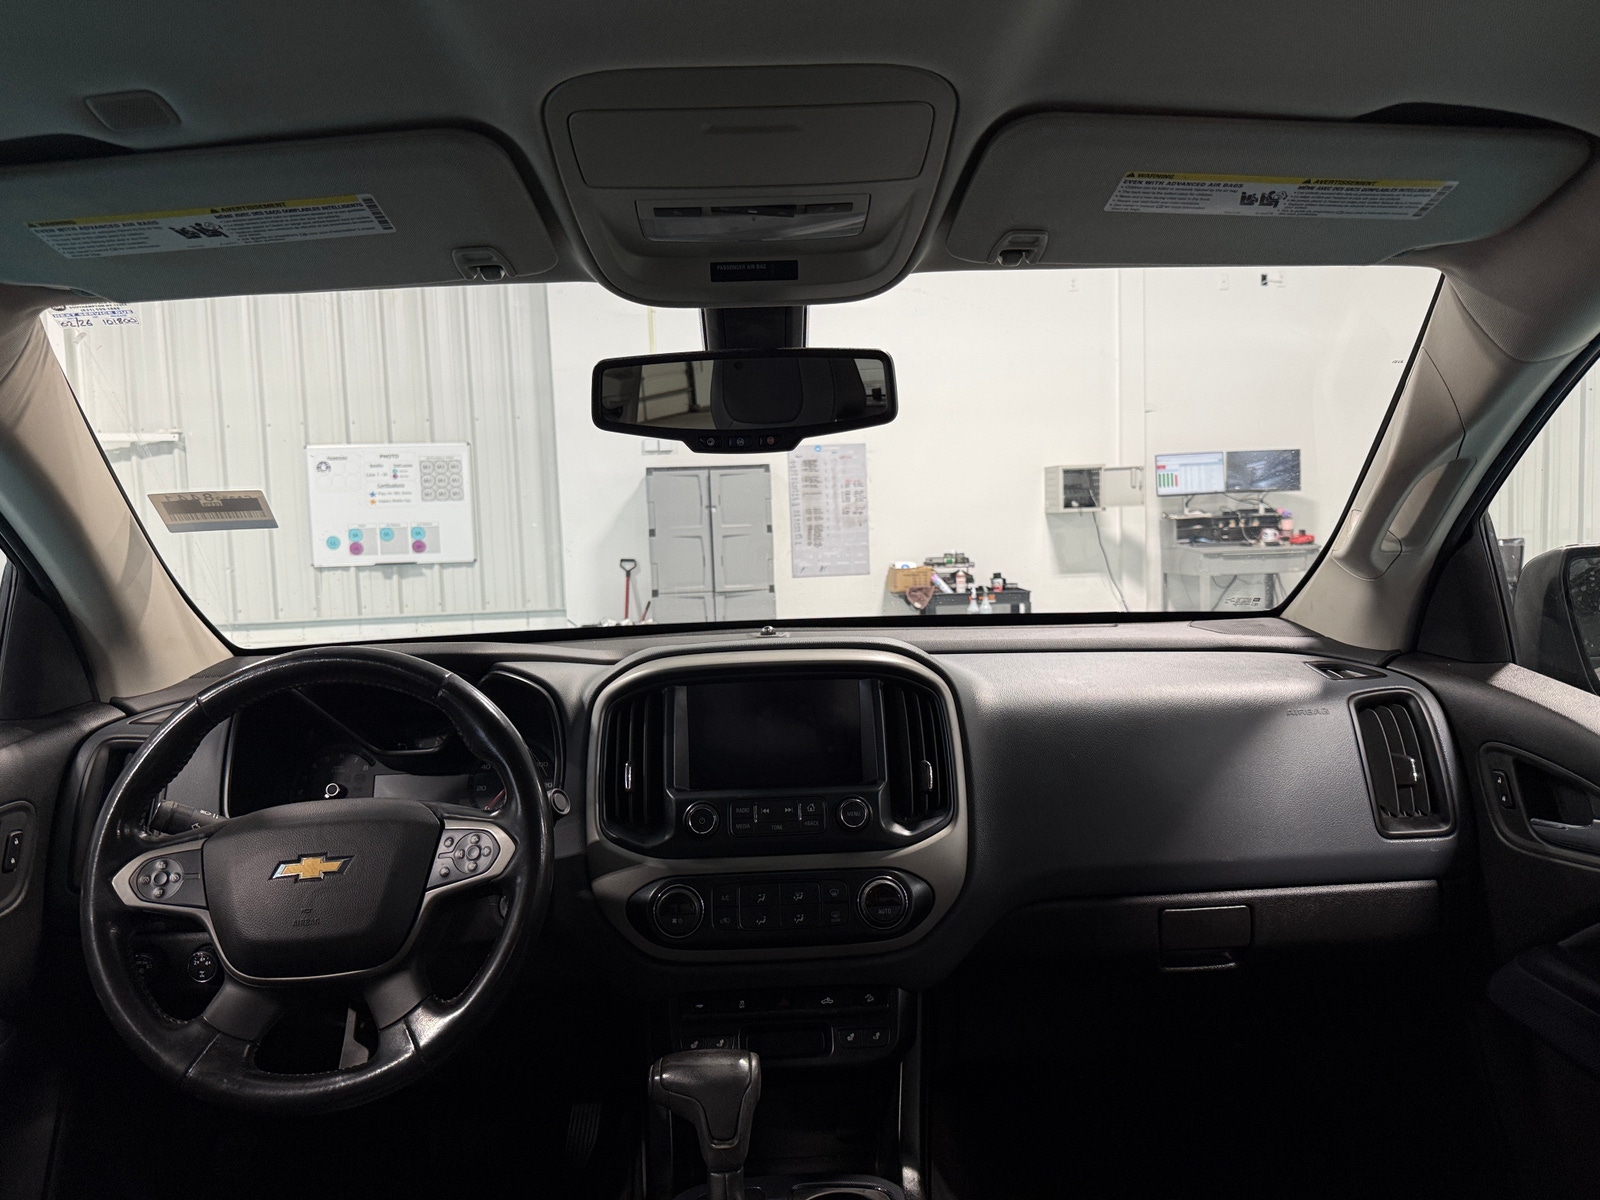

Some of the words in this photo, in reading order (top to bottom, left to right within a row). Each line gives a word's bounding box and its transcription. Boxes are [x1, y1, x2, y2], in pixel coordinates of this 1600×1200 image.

[79, 222, 120, 230] ADVANCED
[60, 317, 93, 327] 02/26
[1287, 708, 1330, 716] AIRBAG
[293, 918, 320, 927] AIRBAG
